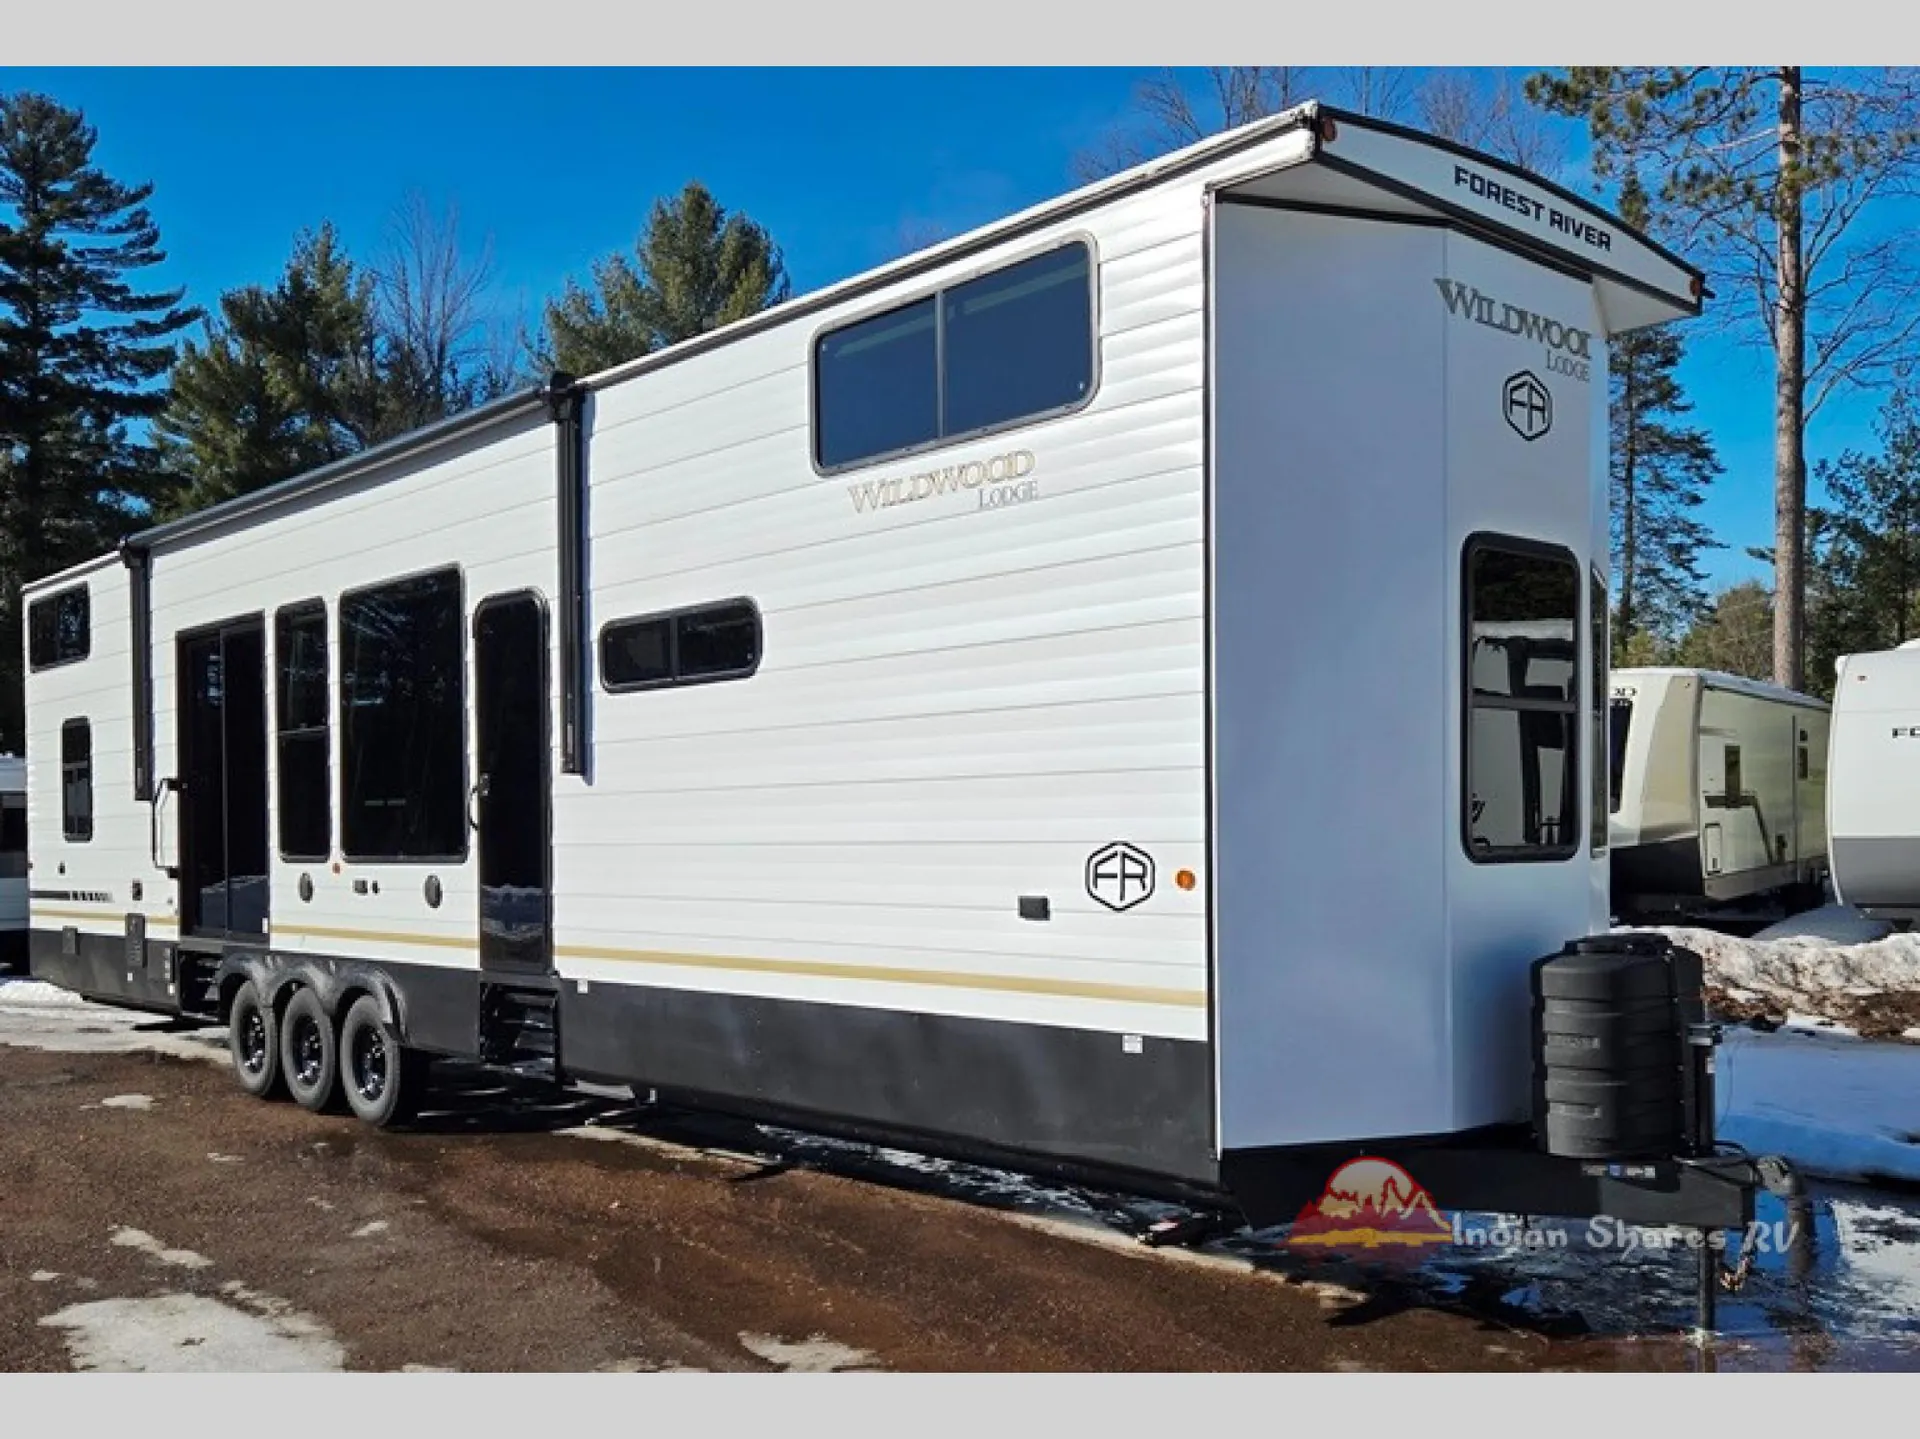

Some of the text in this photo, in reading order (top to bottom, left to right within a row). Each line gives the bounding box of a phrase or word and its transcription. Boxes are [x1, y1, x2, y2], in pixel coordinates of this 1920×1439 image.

[1454, 165, 1612, 251] FOREST RIVER
[1546, 350, 1591, 382] LODGE
[848, 449, 1037, 514] WILDWOOD
[979, 480, 1038, 509] LODGE
